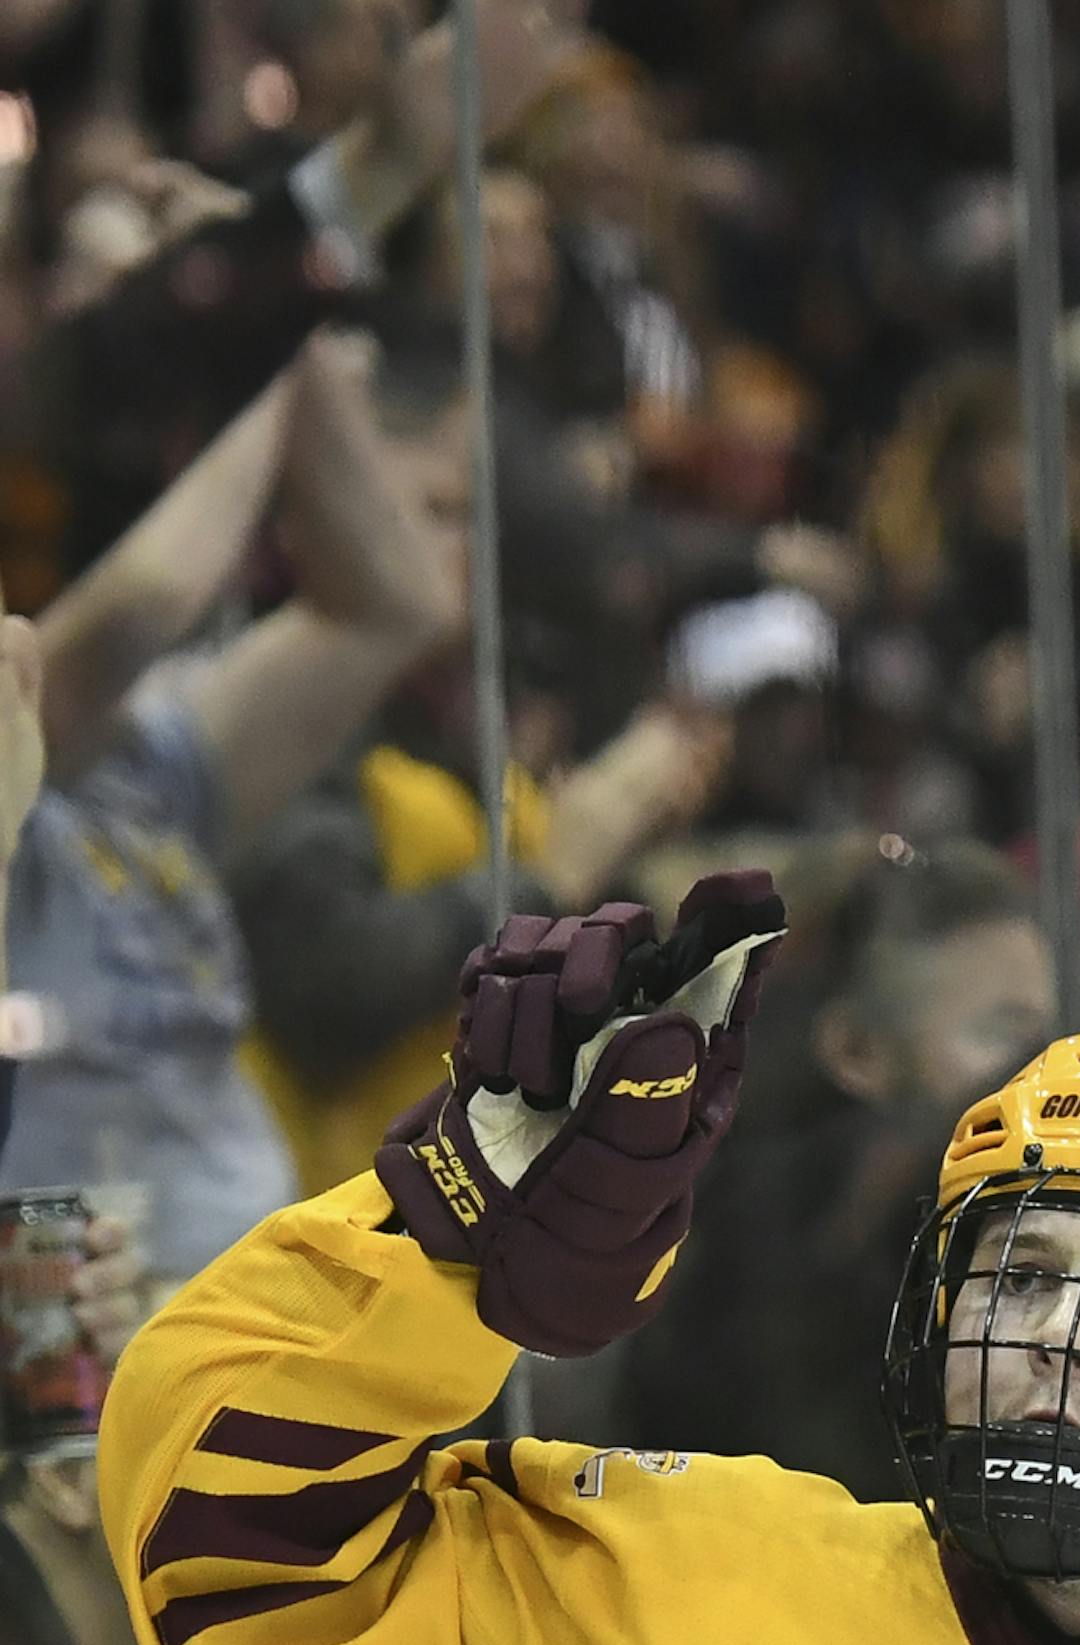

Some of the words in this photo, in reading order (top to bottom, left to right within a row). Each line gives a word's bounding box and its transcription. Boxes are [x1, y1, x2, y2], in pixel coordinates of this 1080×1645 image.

[608, 1063, 698, 1100] CCM
[418, 1143, 479, 1228] CCM
[448, 1155, 474, 1188] PRO
